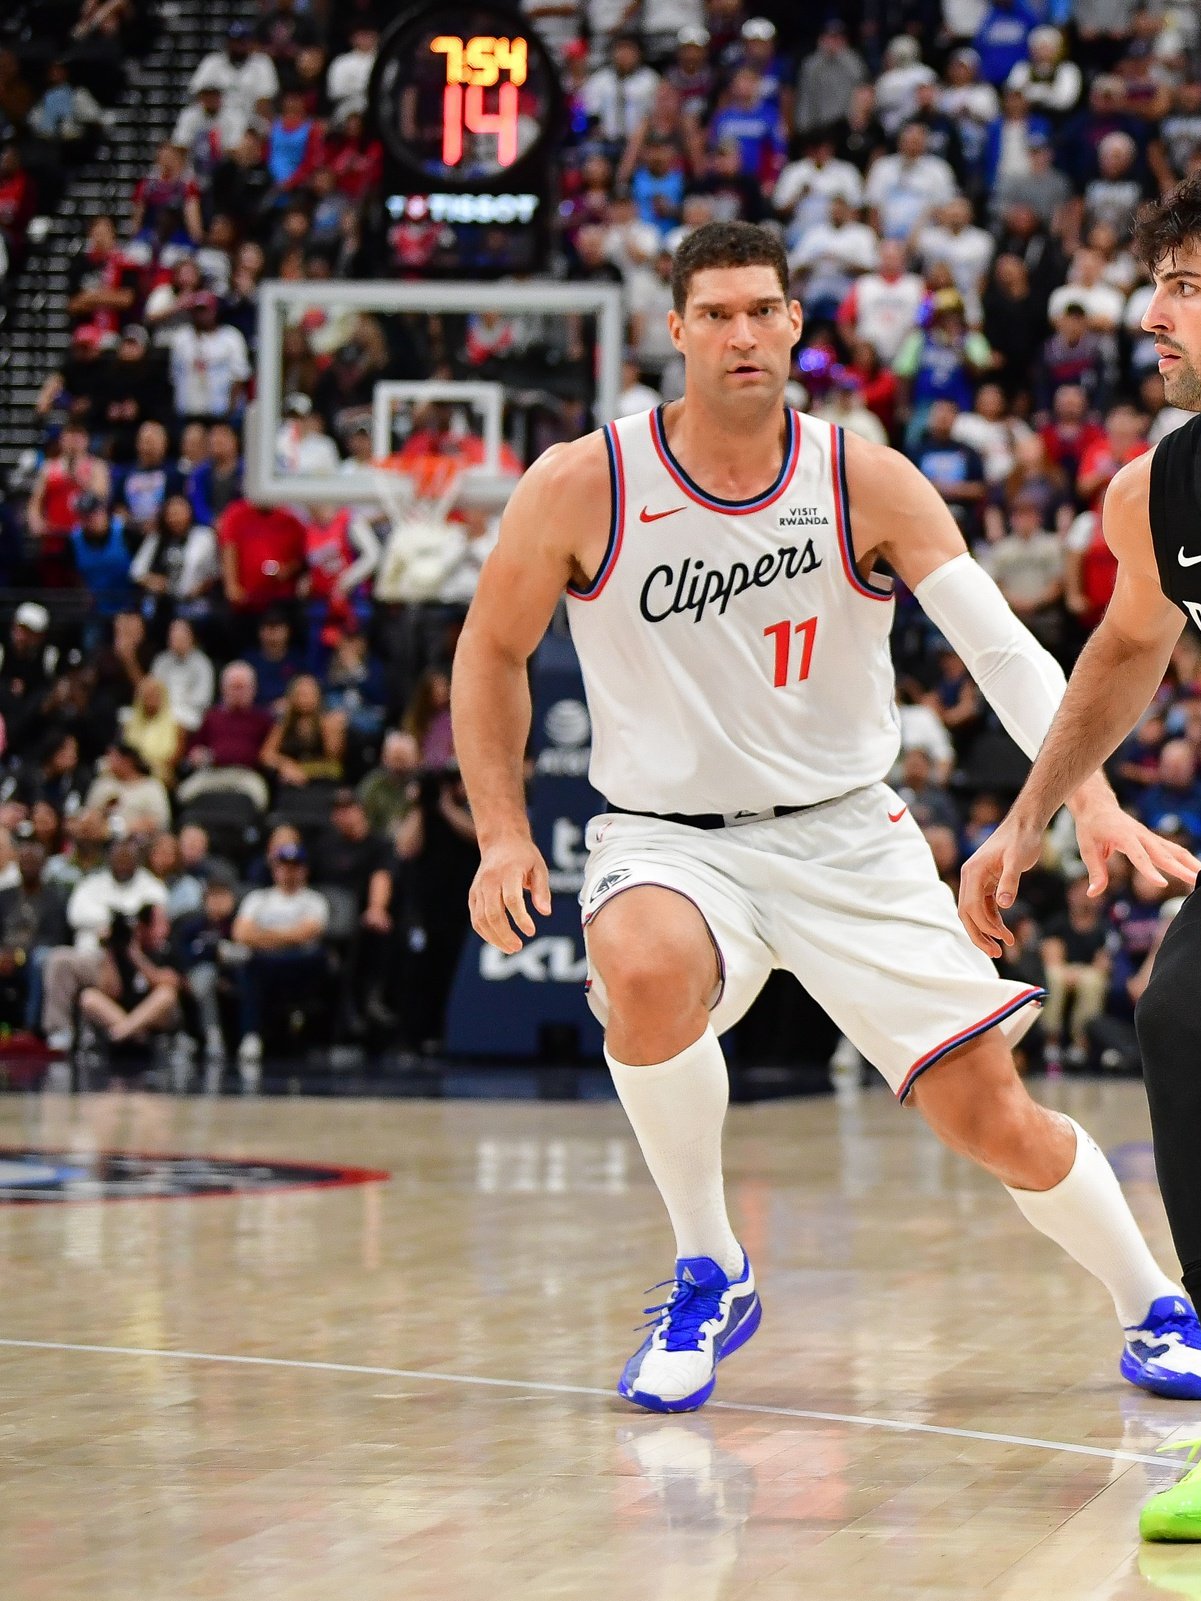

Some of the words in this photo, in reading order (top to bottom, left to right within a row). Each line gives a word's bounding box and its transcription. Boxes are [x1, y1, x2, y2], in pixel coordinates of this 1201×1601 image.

[443, 82, 518, 167] 14
[779, 516, 829, 526] RWANDA
[789, 507, 818, 516] VISIT
[639, 538, 823, 623] Clippers
[763, 616, 818, 687] 11
